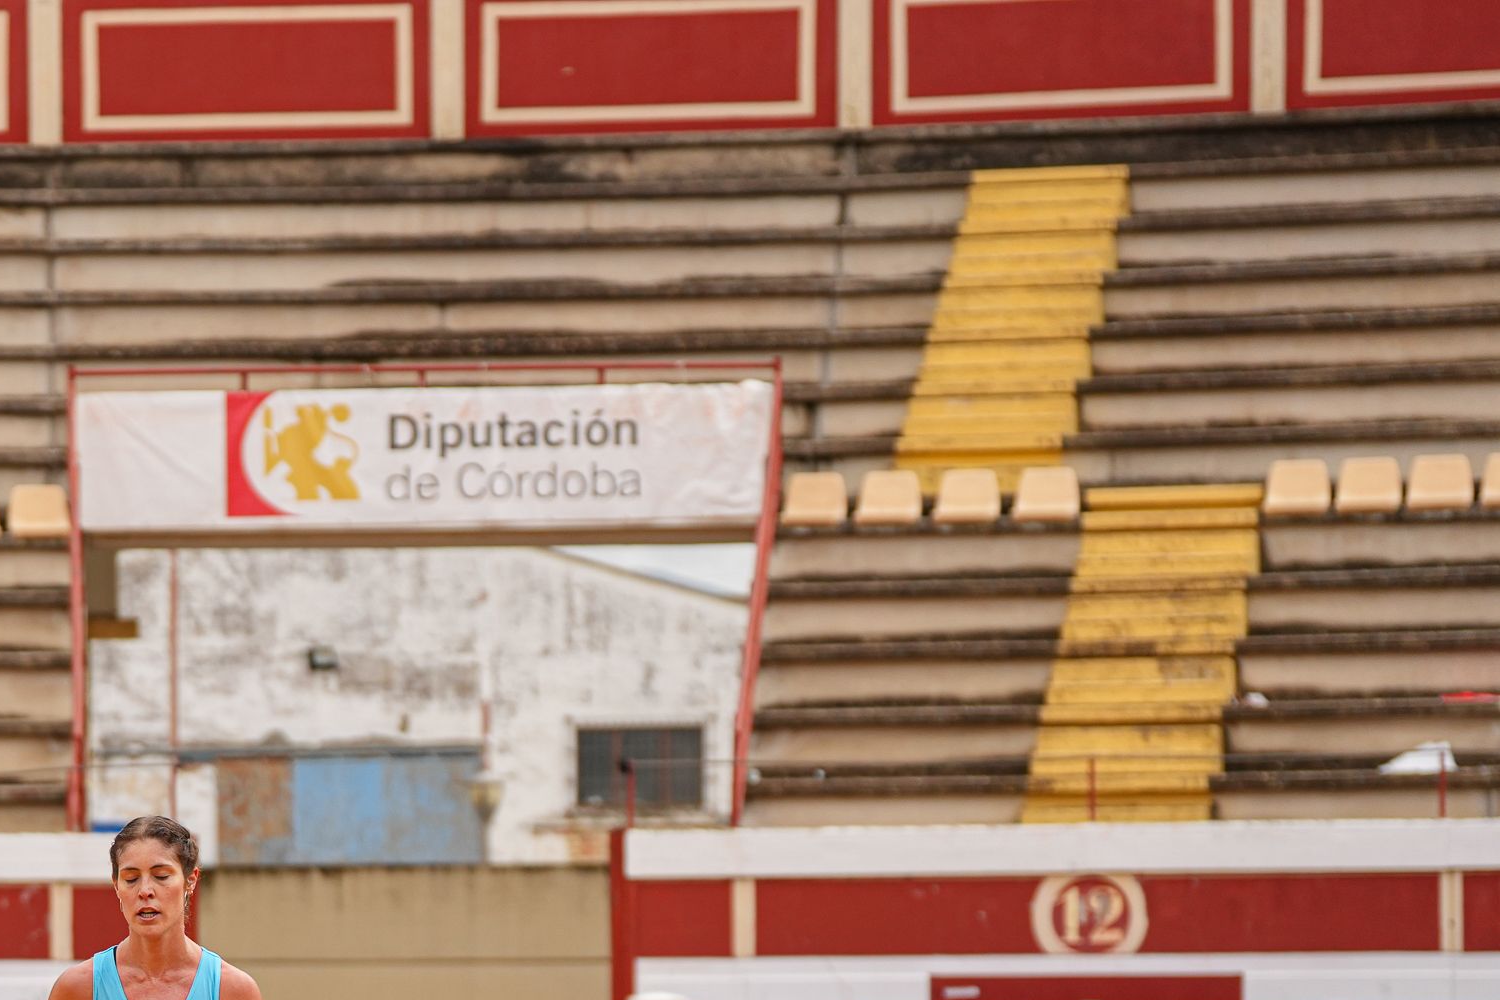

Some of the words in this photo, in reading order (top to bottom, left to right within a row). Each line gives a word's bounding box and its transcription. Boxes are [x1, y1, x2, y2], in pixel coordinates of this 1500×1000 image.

[387, 408, 639, 458] Diputación
[385, 465, 440, 502] de
[457, 461, 642, 501] Córdoba
[1060, 884, 1125, 945] 12
